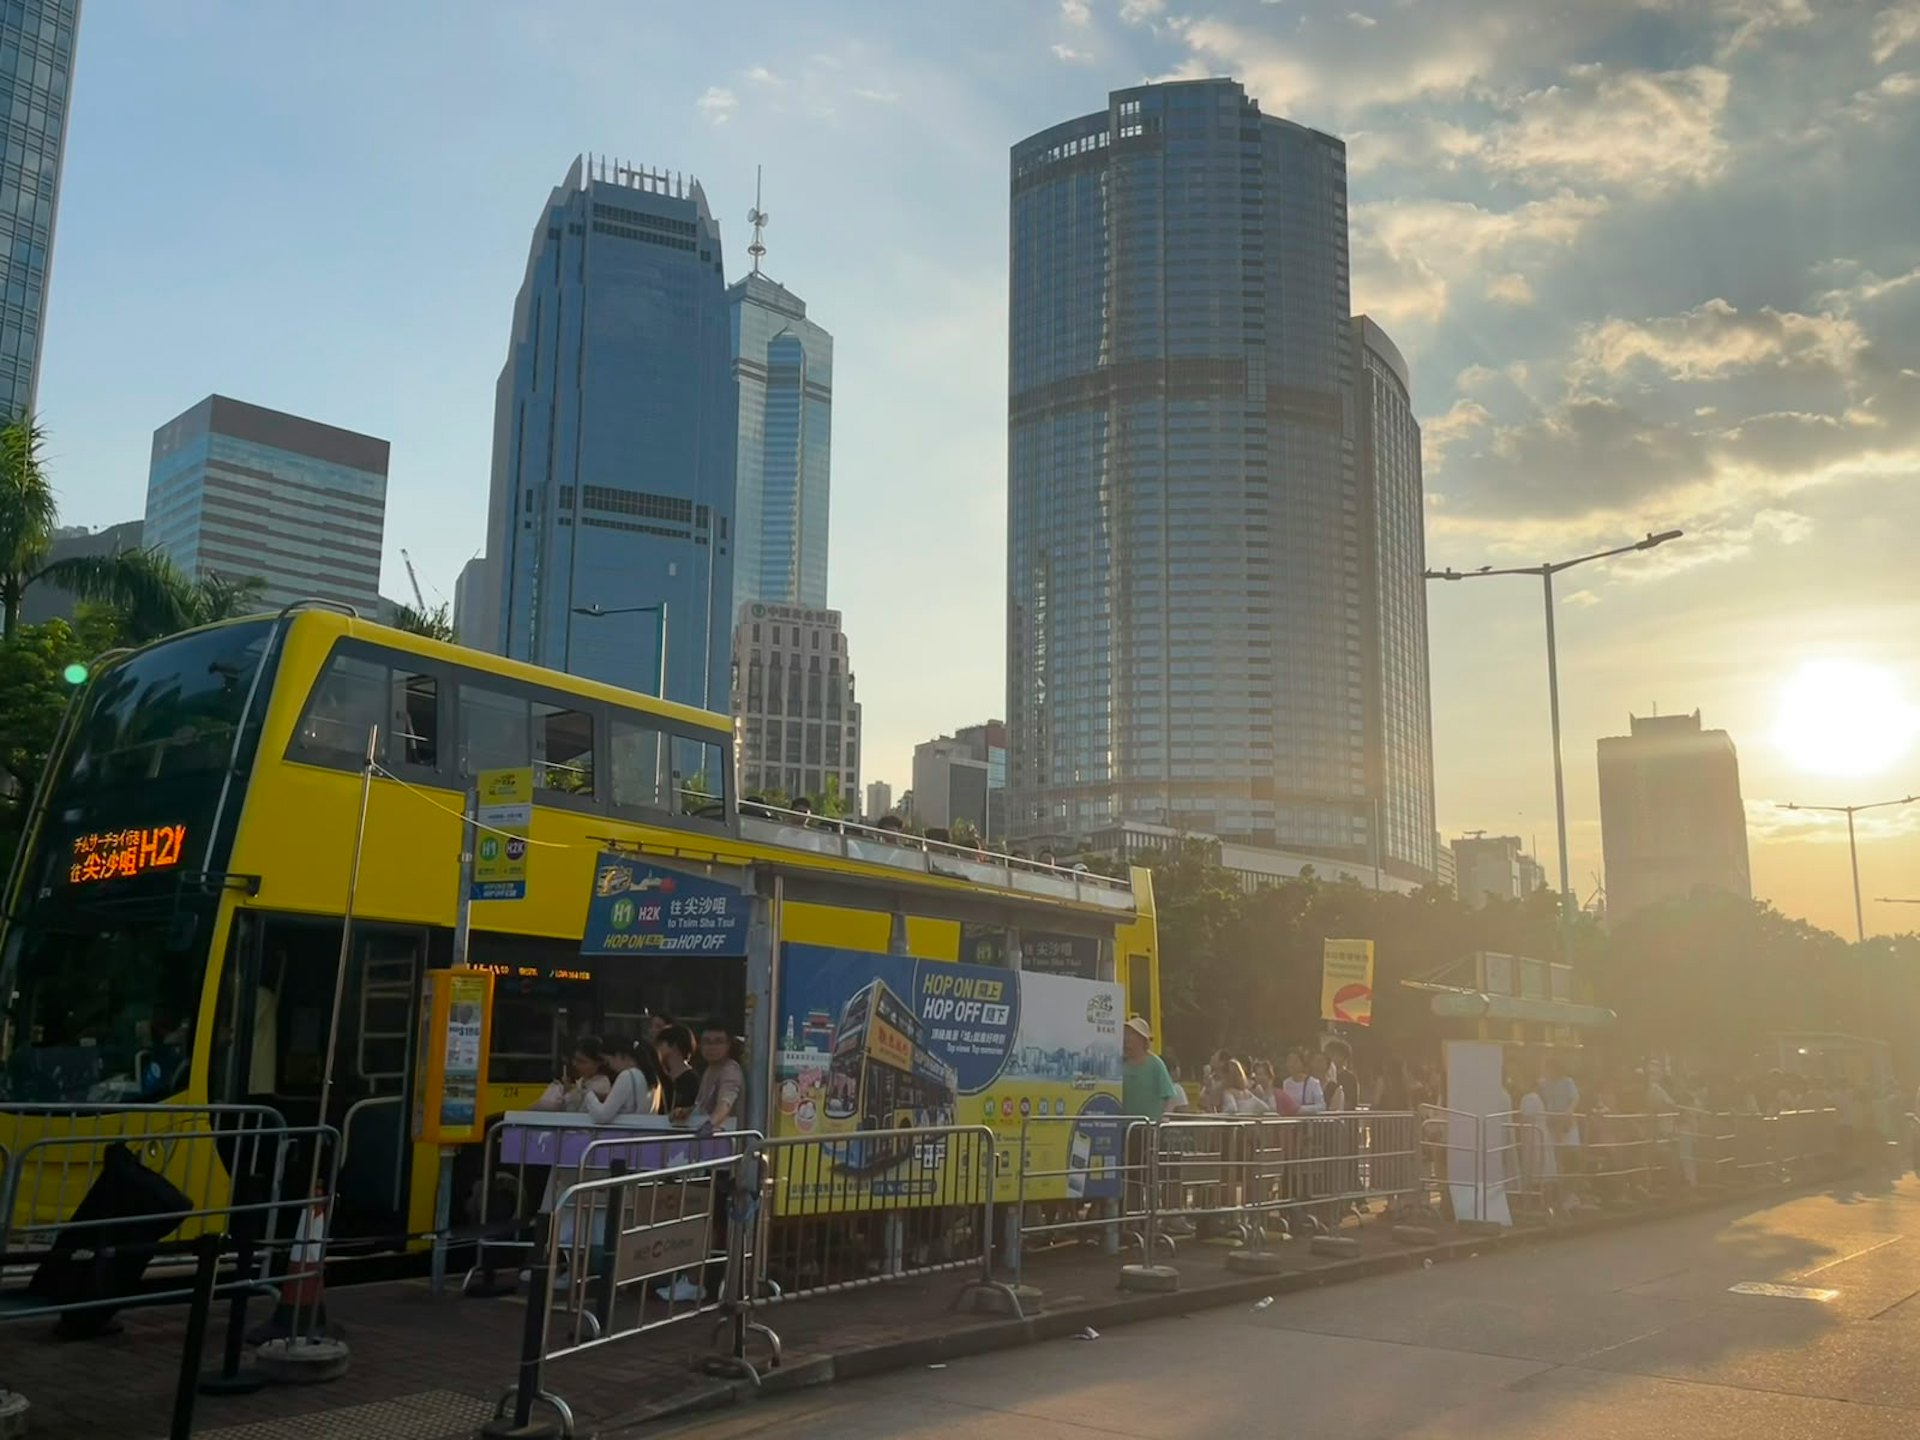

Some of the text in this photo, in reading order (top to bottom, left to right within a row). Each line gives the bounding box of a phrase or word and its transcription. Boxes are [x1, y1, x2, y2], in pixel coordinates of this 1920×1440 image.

[613, 904, 631, 922] H1
[638, 906, 661, 921] H2K
[670, 897, 726, 915] 往尖沙咀
[668, 917, 735, 928] to Tsim Sha Tsui
[603, 934, 628, 949] HOP
[628, 934, 645, 949] ON
[676, 934, 700, 949] HOP
[702, 934, 726, 949] OFF
[922, 973, 953, 996] HOP
[954, 977, 974, 998] ON
[922, 998, 954, 1020] HOP
[954, 1000, 982, 1022] OFF
[503, 1087, 519, 1098] 274
